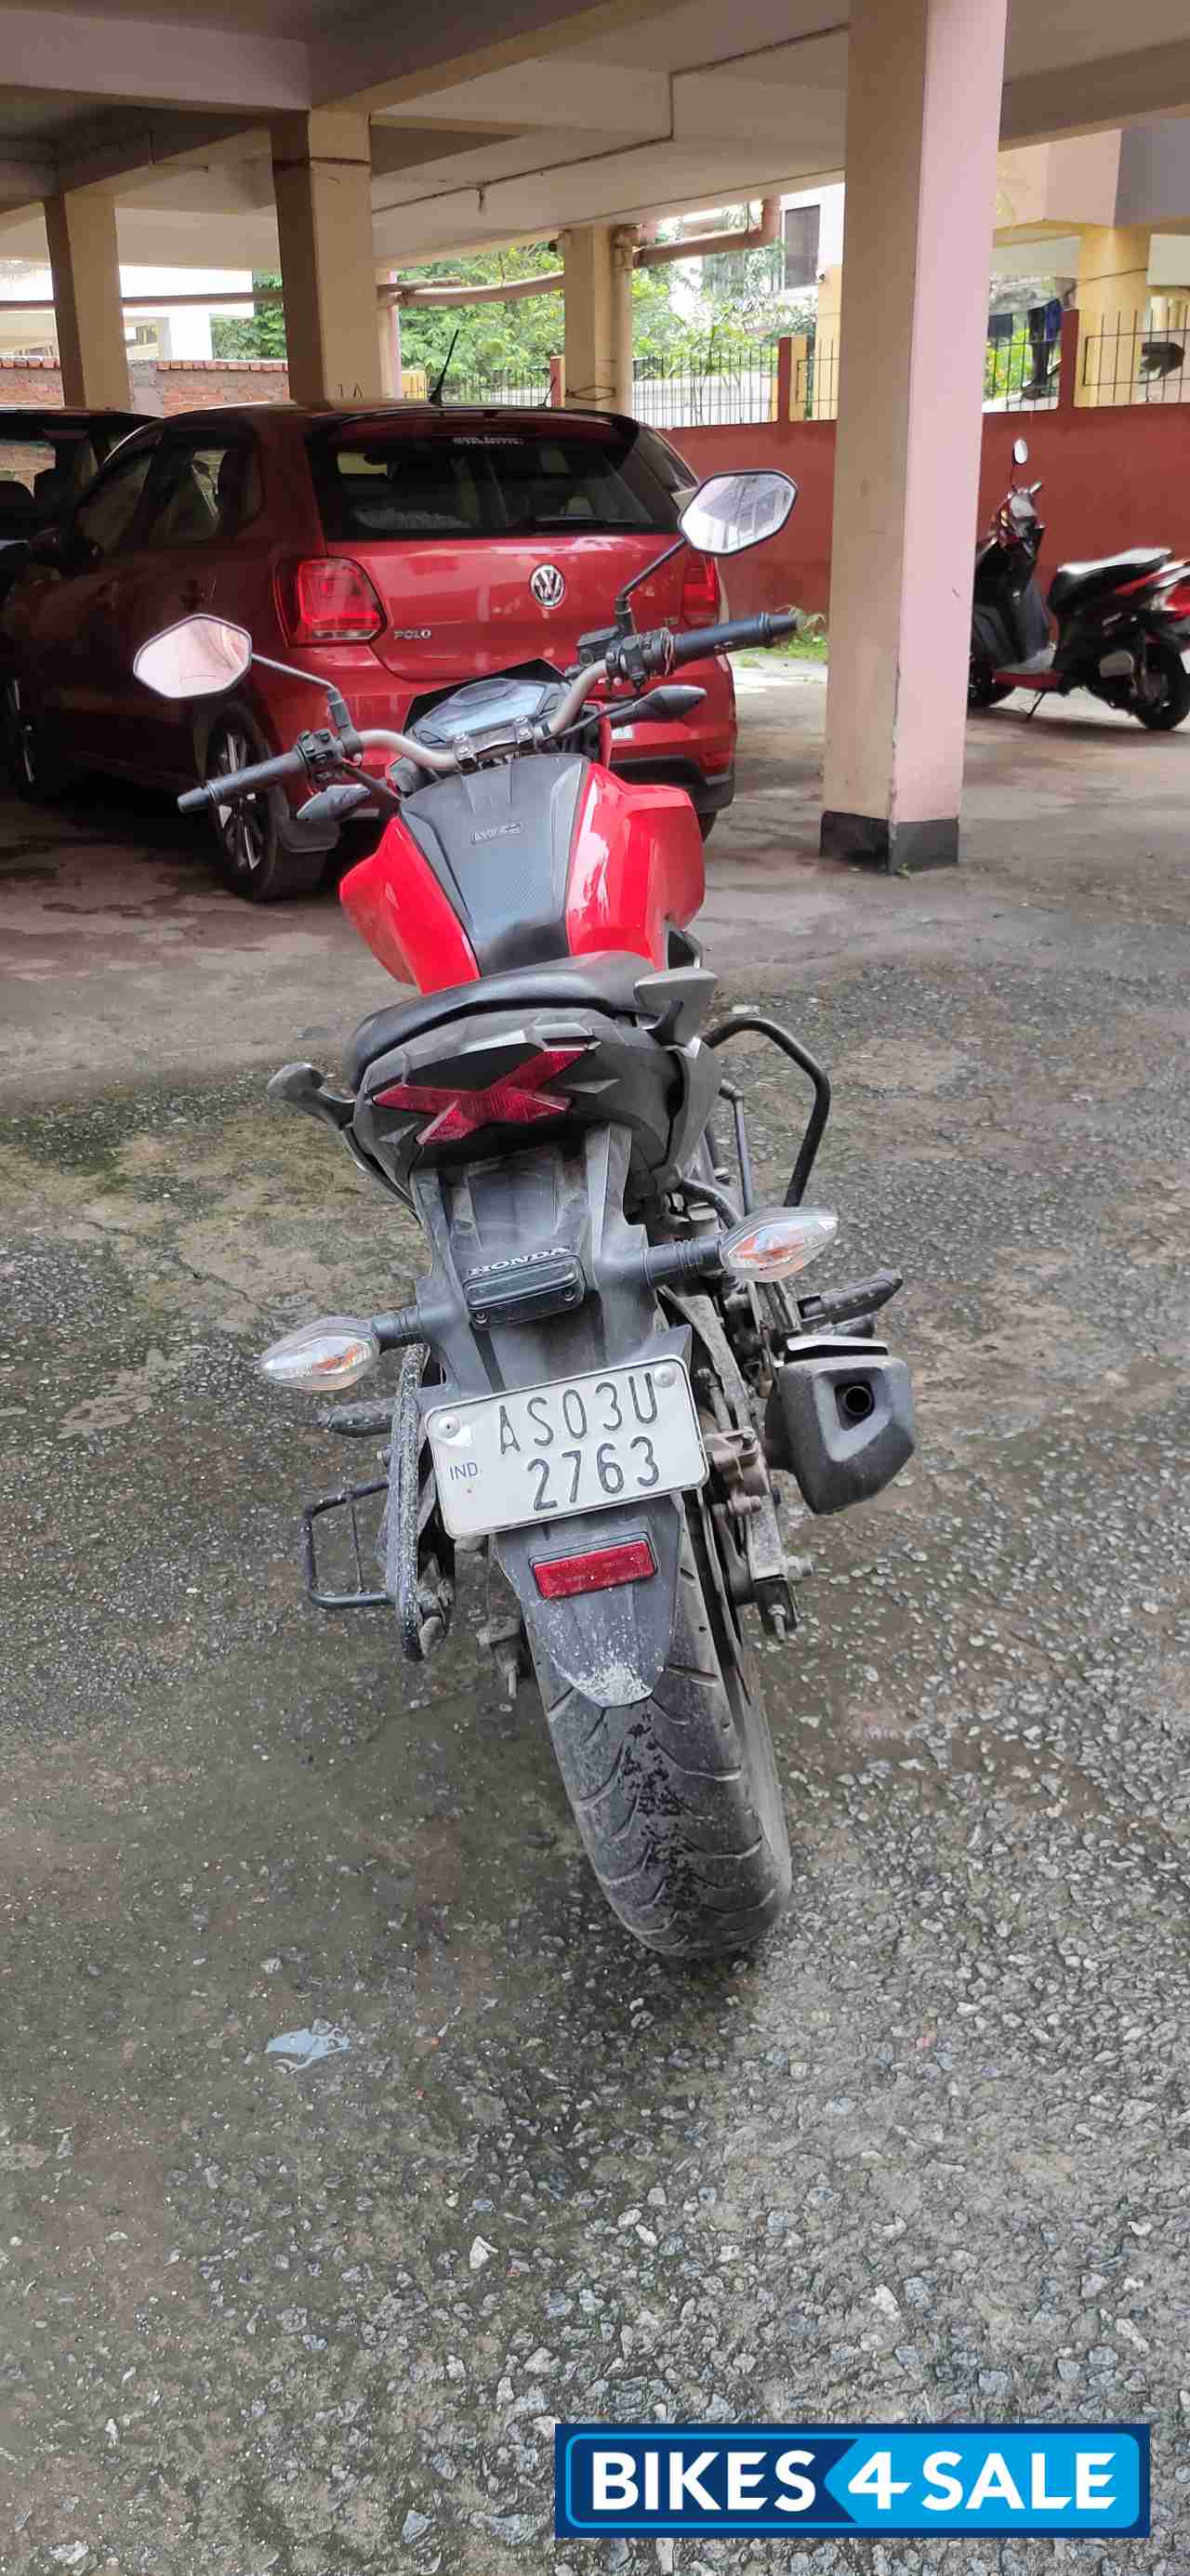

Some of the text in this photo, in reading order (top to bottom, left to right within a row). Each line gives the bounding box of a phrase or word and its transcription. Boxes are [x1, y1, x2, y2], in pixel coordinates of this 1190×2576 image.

[393, 628, 432, 641] POLO
[469, 1247, 570, 1277] HONDA
[497, 1371, 658, 1456] AS03U
[449, 1461, 479, 1481] IND
[526, 1435, 660, 1512] 2763
